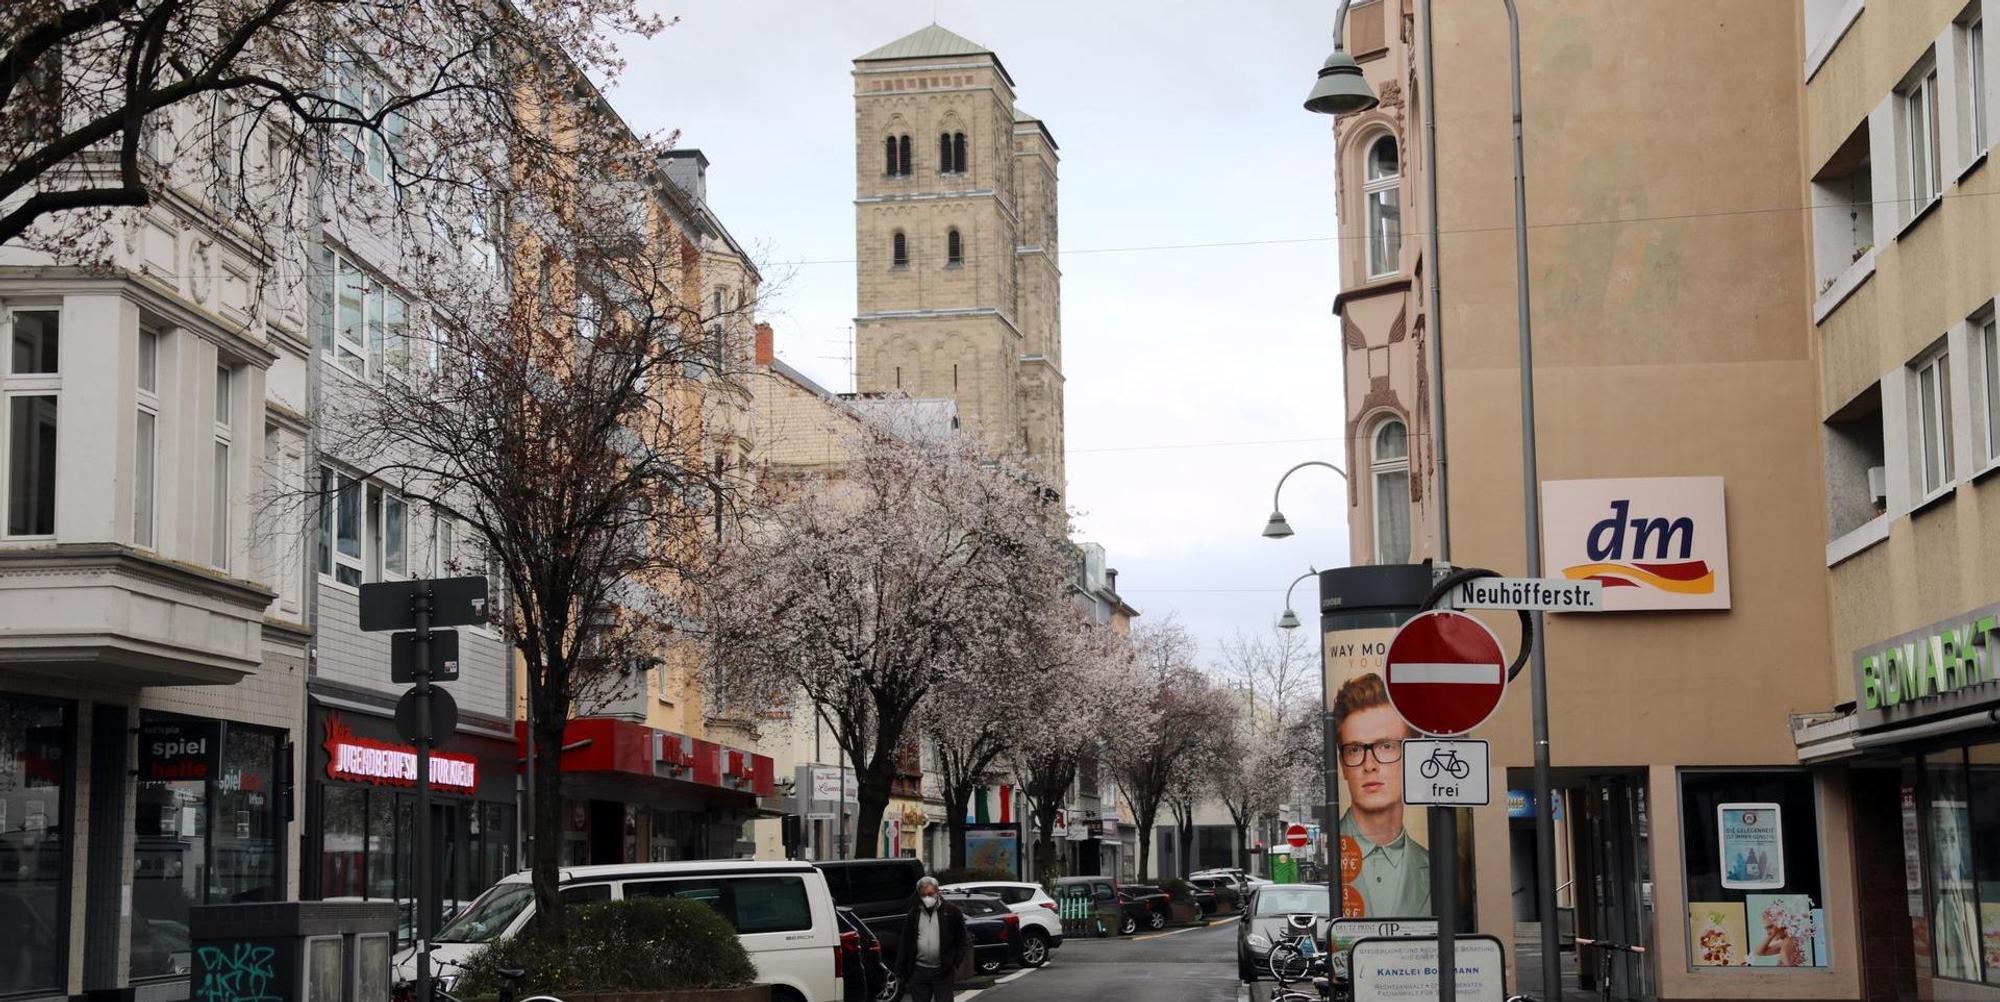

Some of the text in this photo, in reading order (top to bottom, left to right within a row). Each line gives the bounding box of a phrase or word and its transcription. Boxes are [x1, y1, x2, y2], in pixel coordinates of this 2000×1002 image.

[1586, 499, 1694, 562] dm
[1462, 582, 1595, 607] Neuhöfferstr.
[1330, 644, 1355, 659] WAY
[1862, 614, 1996, 711] BIOMARKT
[152, 737, 207, 760] spiel
[1432, 783, 1459, 797] frei
[1377, 968, 1420, 977] KANZLEI
